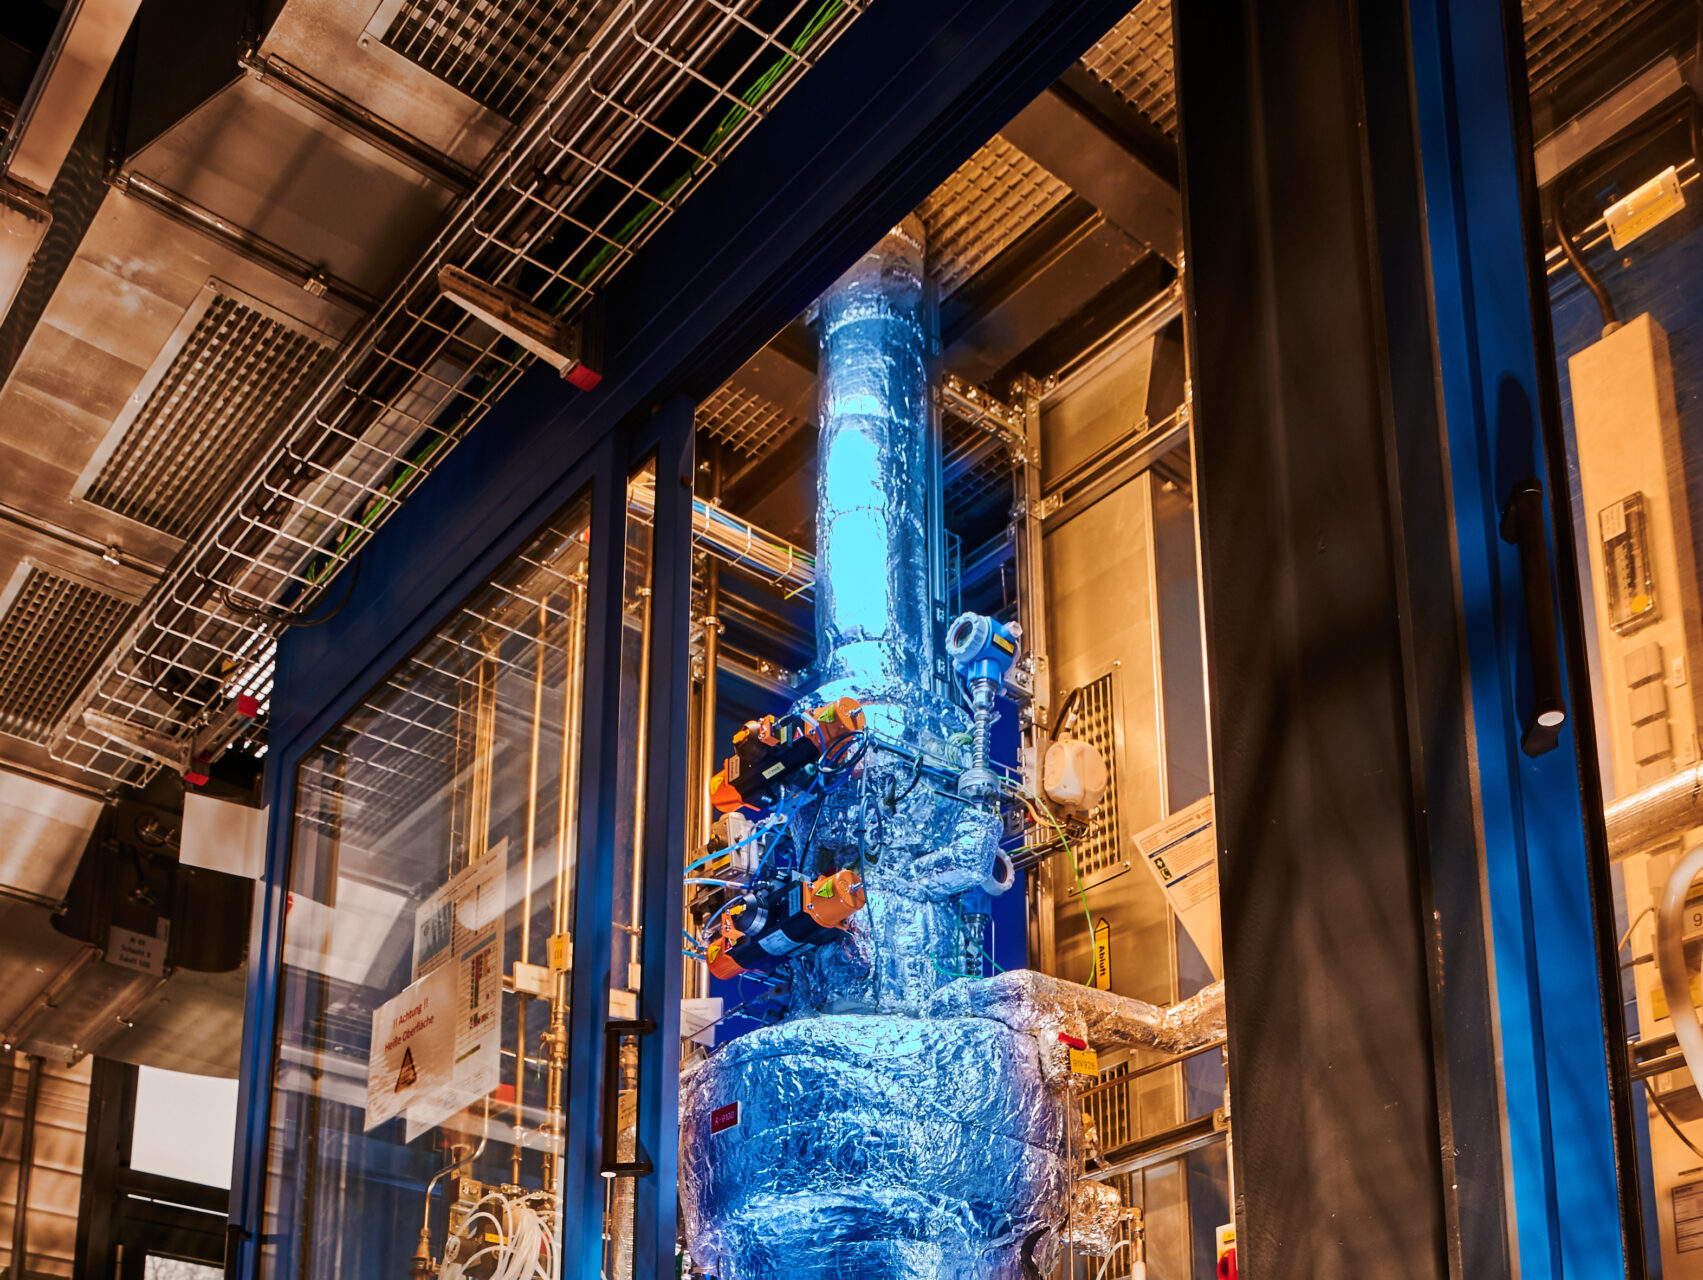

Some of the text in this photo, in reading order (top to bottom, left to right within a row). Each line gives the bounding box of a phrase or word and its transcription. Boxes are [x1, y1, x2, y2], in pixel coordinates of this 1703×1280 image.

[1098, 945, 1107, 977] Abluft
[399, 1004, 422, 1025] Achtung
[384, 1015, 434, 1053] Heiße Oberfläche
